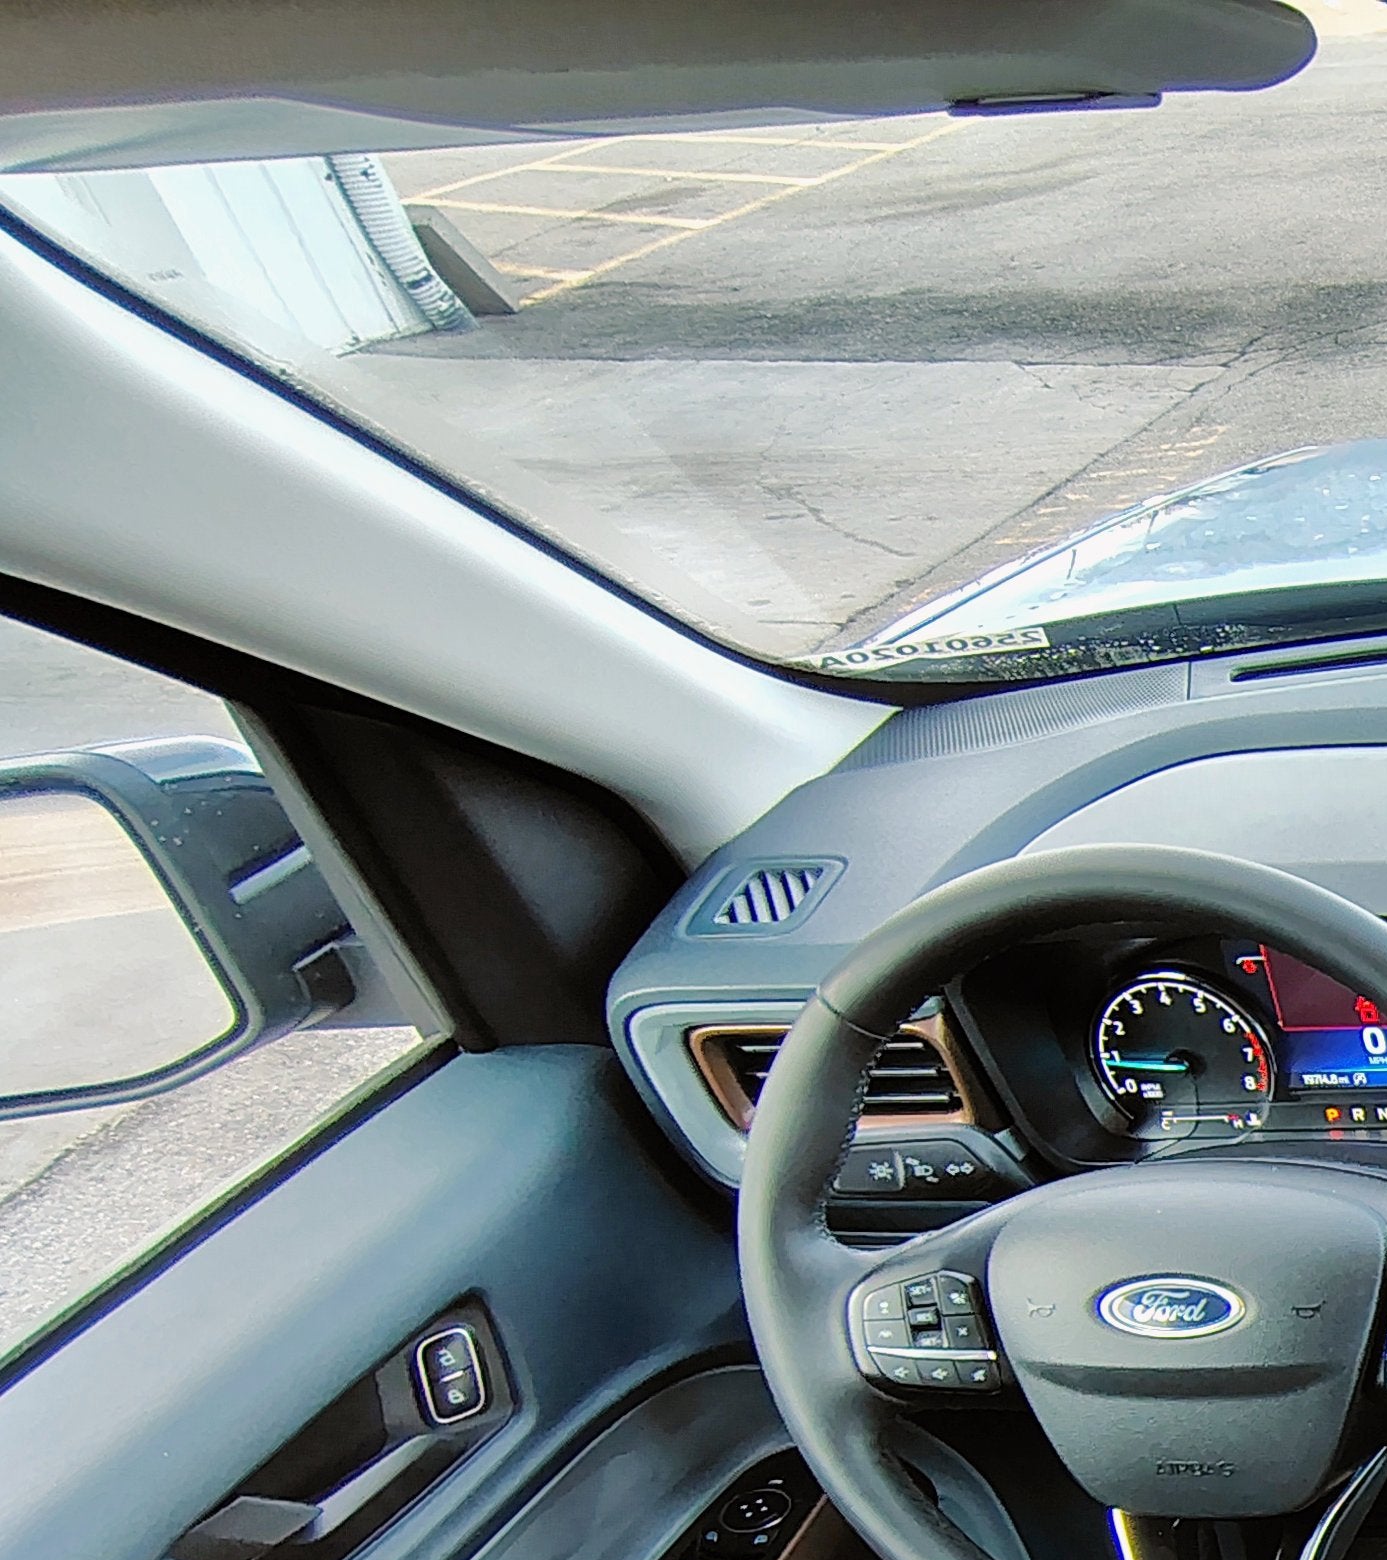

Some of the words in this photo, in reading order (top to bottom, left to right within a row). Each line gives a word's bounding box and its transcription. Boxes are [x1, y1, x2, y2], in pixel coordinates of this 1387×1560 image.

[1129, 1000, 1143, 1014] 3
[1193, 998, 1206, 1013] 5
[1113, 1021, 1126, 1035] 2
[1223, 1019, 1236, 1033] 6
[1362, 1026, 1387, 1055] 0
[1242, 1048, 1253, 1061] 7
[1125, 1079, 1138, 1092] 0
[1245, 1076, 1256, 1090] 8
[1325, 1107, 1341, 1121] P
[1351, 1107, 1366, 1121] R
[1132, 1288, 1207, 1323] Ford
